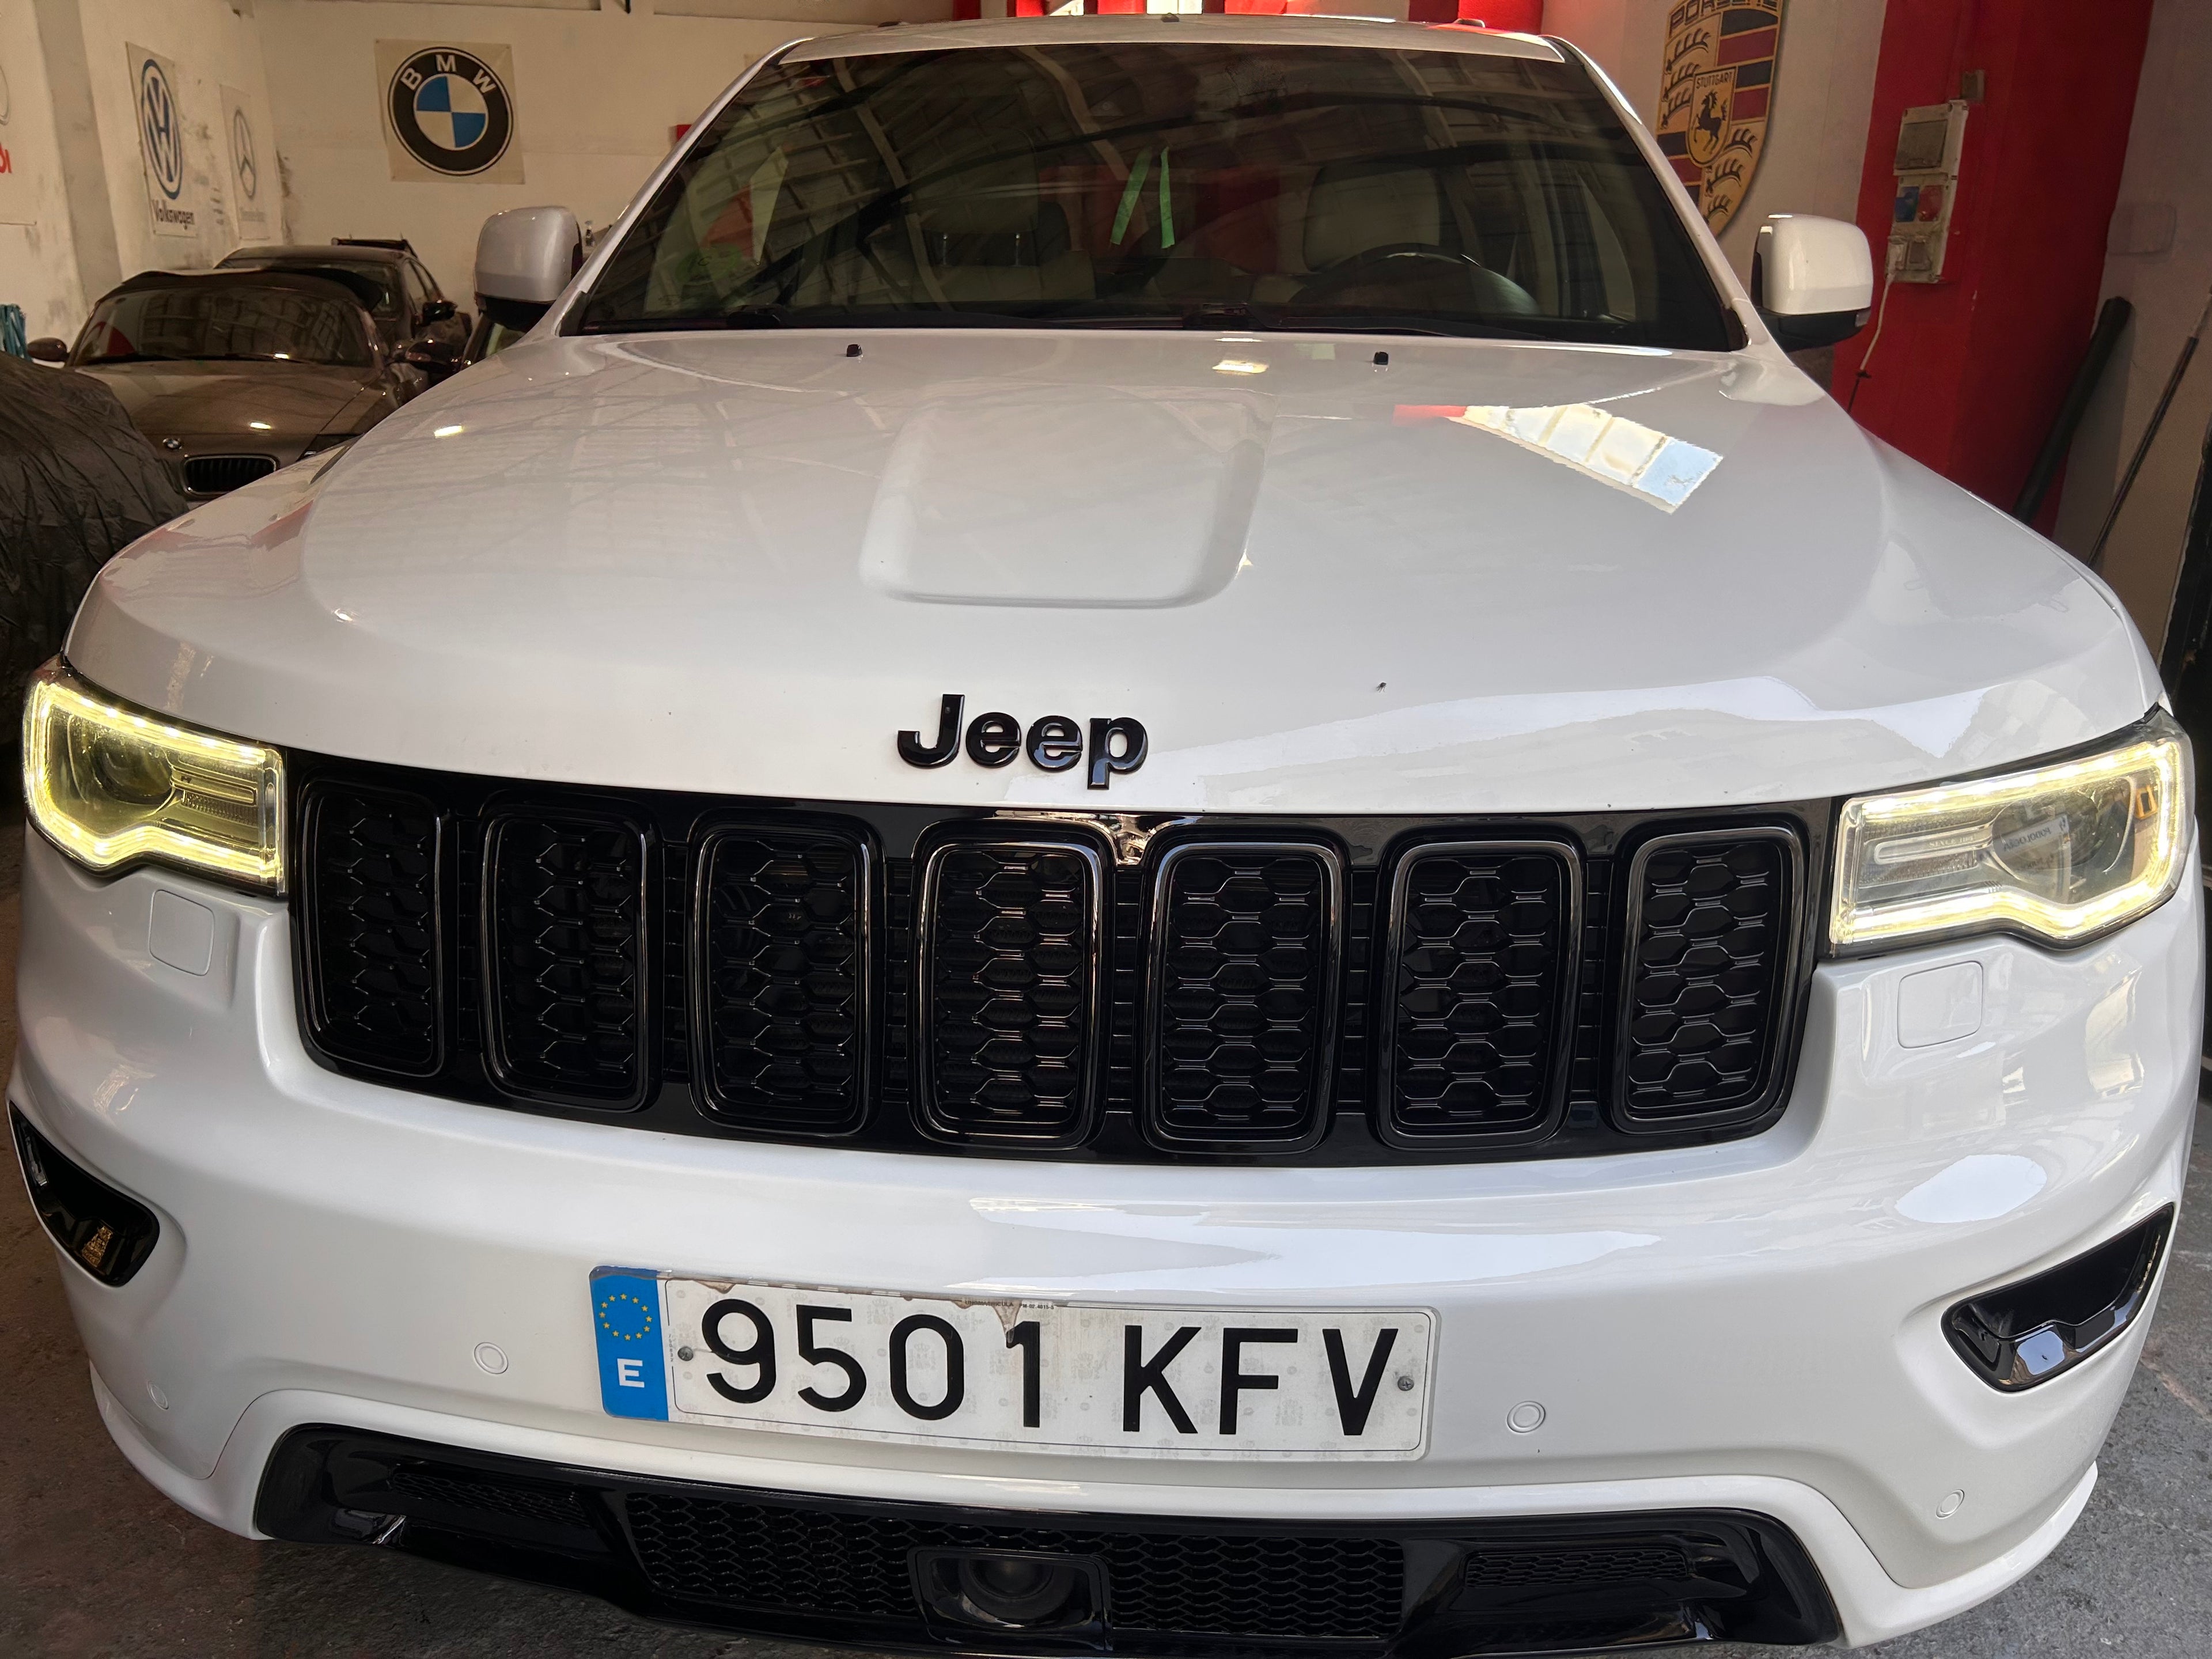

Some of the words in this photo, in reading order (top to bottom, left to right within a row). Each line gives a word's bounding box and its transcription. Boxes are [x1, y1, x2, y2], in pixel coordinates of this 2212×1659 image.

[400, 54, 496, 93] BMW
[1696, 71, 1733, 89] STUTTGART
[151, 199, 195, 230] Volkswagen
[897, 694, 1148, 790] Jeep
[617, 1358, 645, 1388] E
[702, 1298, 1040, 1428] 9501
[1123, 1325, 1398, 1435] KFV
